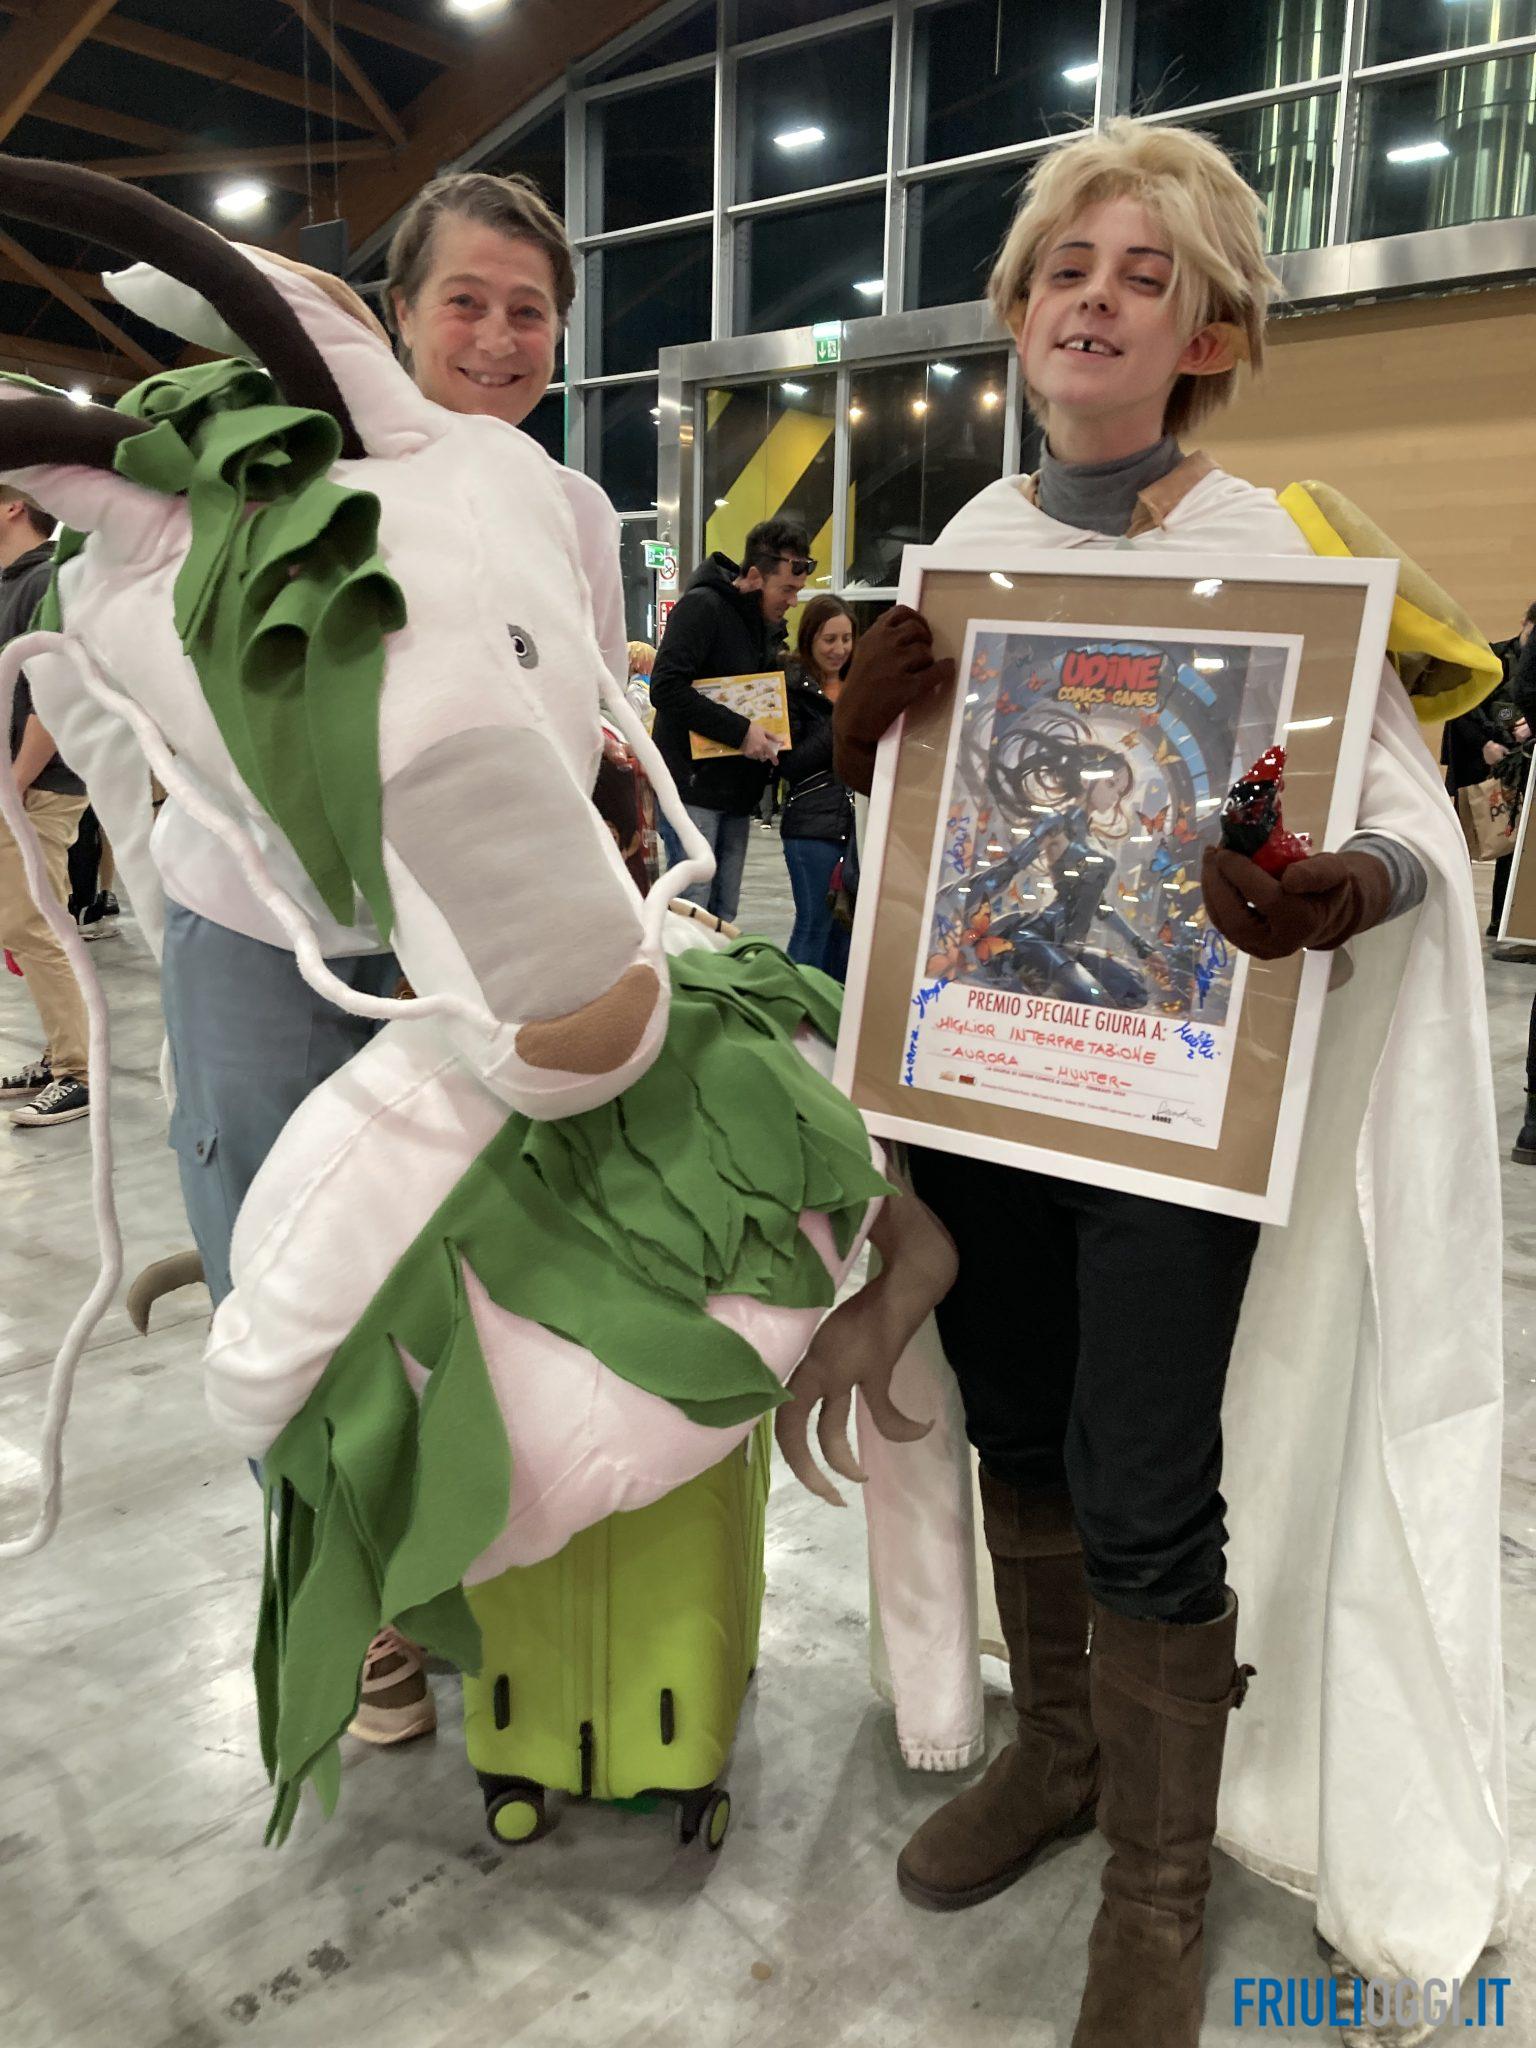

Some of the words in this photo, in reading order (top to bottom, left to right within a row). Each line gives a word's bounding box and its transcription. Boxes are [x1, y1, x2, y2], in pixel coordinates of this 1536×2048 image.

[1112, 690, 1157, 708] GAMES
[967, 990, 1021, 1016] PREMIO
[1025, 999, 1091, 1029] SPECIALE
[1095, 1011, 1146, 1038] GIURIA
[1151, 1020, 1168, 1042] A:
